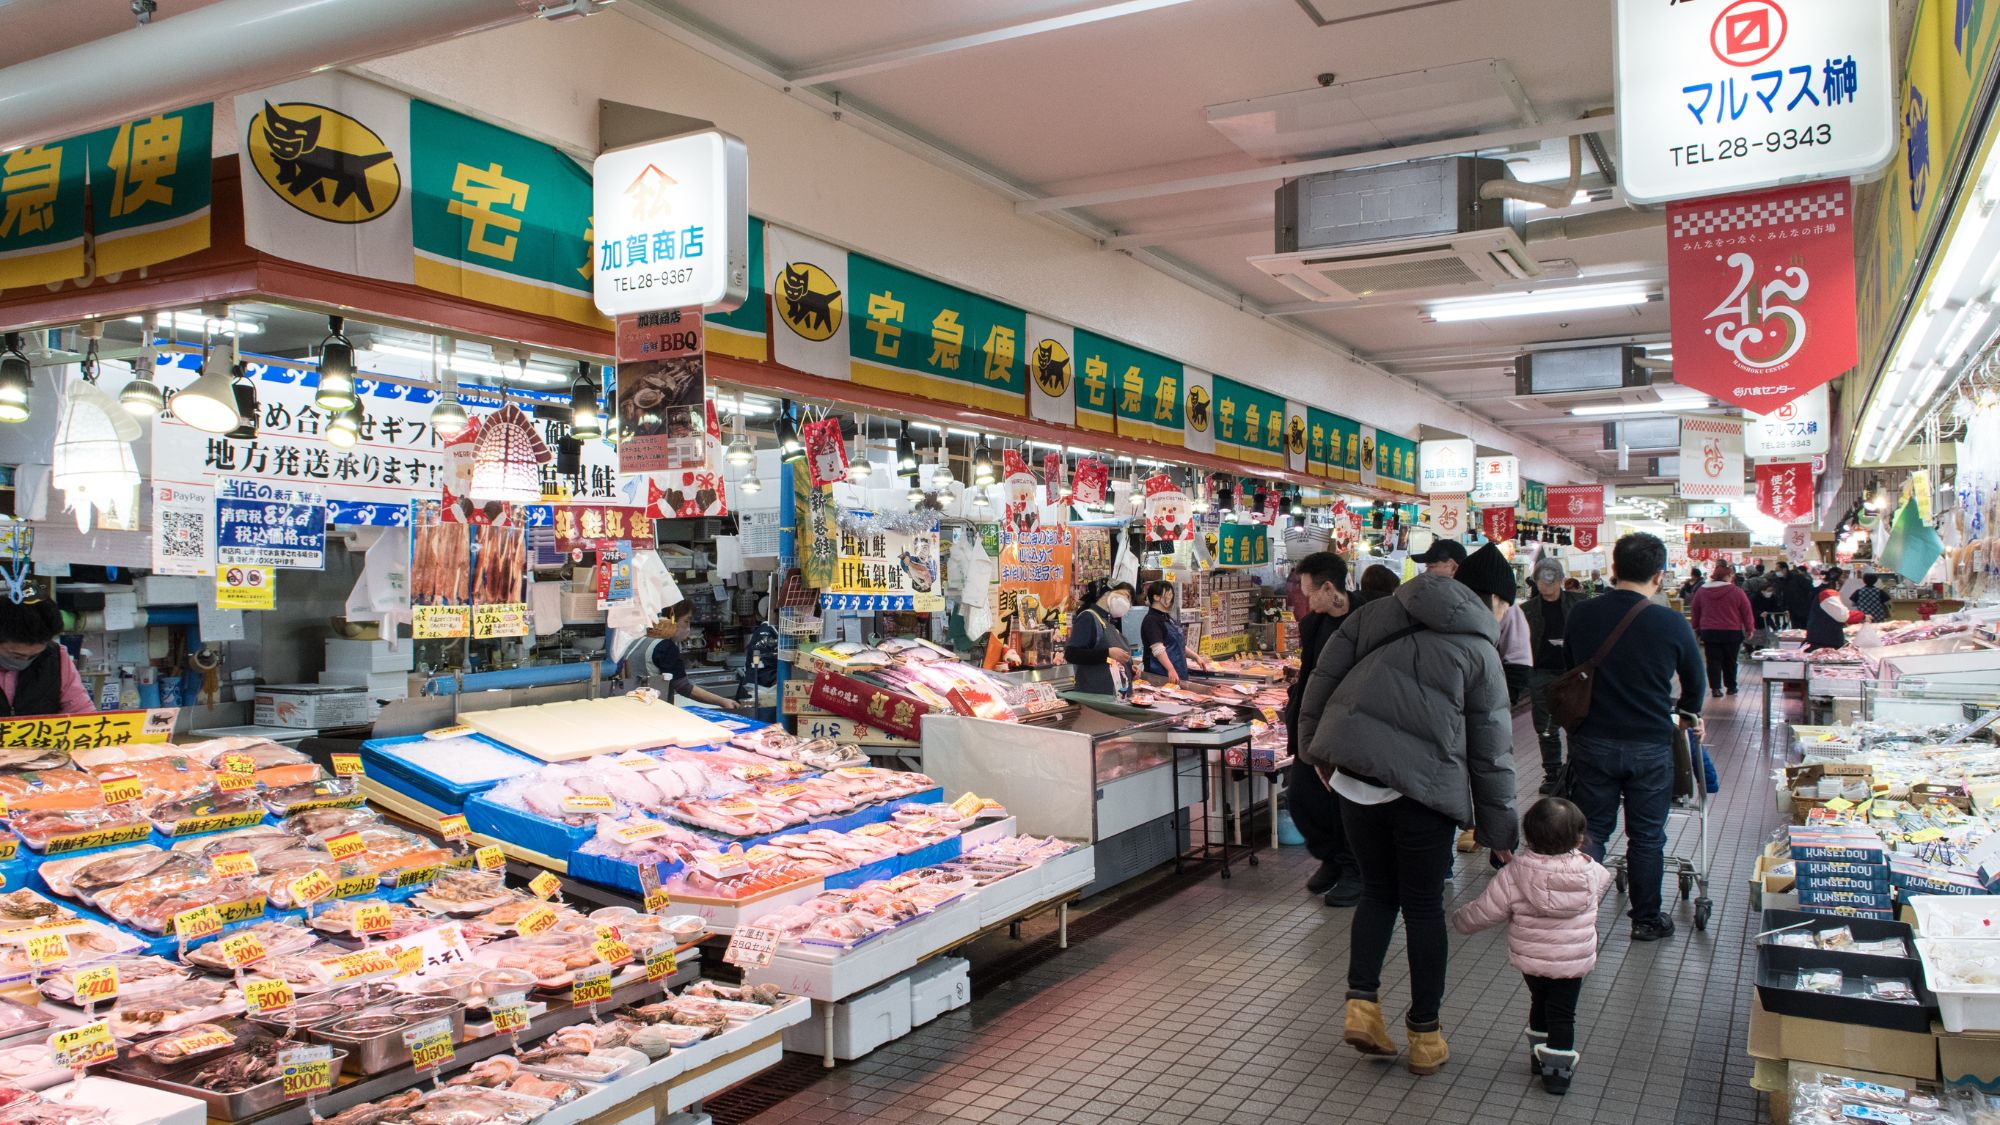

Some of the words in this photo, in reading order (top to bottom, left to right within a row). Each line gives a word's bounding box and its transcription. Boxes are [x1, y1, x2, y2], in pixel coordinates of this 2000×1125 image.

[1682, 55, 1857, 124] マルマス榊
[1683, 223, 1836, 251] みんなをつなぐ、みんなの市場
[601, 225, 704, 272] 加賀商店
[638, 311, 681, 327] 加賀商店
[1703, 252, 1809, 367] 45
[660, 331, 697, 352] BBQ
[866, 290, 1015, 383] 宅急便
[1764, 361, 1790, 374] CENTER
[1085, 354, 1177, 422] 宅急便
[1219, 396, 1285, 448] 宅急便
[1312, 423, 1358, 466] 宅急便
[1379, 442, 1415, 480] 宅急便
[1425, 467, 1468, 479] 加賀商店
[174, 490, 205, 502] PayPay
[1771, 475, 1784, 518] 使えます。
[1785, 468, 1796, 505] ペイペイ
[555, 509, 605, 539] 紅鮭
[606, 509, 653, 539] 紅鮭
[235, 526, 321, 547] 税込価格です。
[1224, 535, 1264, 562] 宅急便
[841, 562, 904, 590] 甘塩銀鮭
[105, 787, 141, 803] 6100円
[175, 814, 262, 834] 海鮮ギフトセットF
[48, 827, 148, 851] 海鮮ギフトセットE
[332, 841, 365, 857] 5800円
[1806, 848, 1868, 861] KUNSEIDOU
[1810, 863, 1872, 876] KUNSEIDOU
[1810, 878, 1872, 891] KUNSEIDOU
[1906, 876, 1971, 896] KUNSEIDOU
[1813, 892, 1875, 906] KUNSEIDOU
[363, 914, 392, 929] 500円
[234, 944, 263, 963] 500円
[258, 990, 294, 1009] 500円
